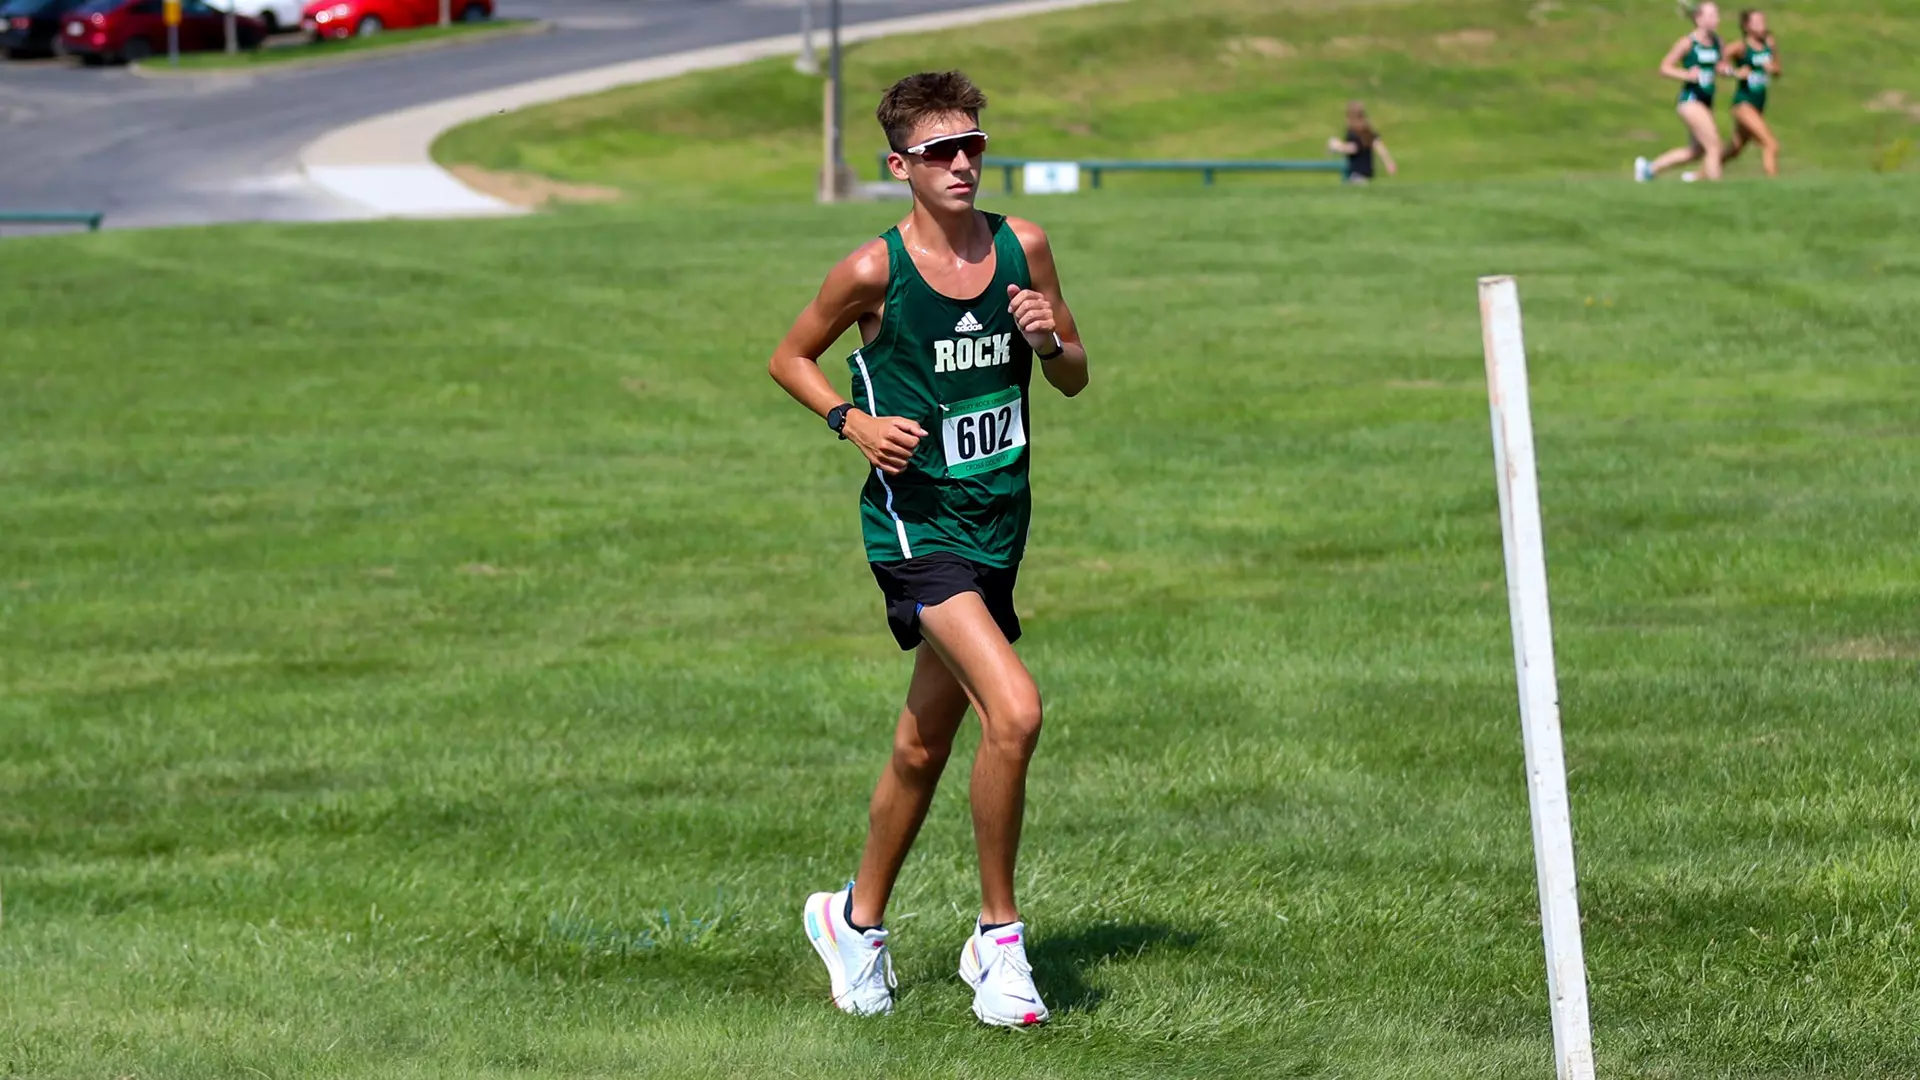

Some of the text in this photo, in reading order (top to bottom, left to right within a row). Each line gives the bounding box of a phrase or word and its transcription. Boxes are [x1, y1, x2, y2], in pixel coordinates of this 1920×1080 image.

[955, 323, 983, 333] adidas
[934, 332, 1011, 373] ROCK
[957, 406, 1012, 460] 602
